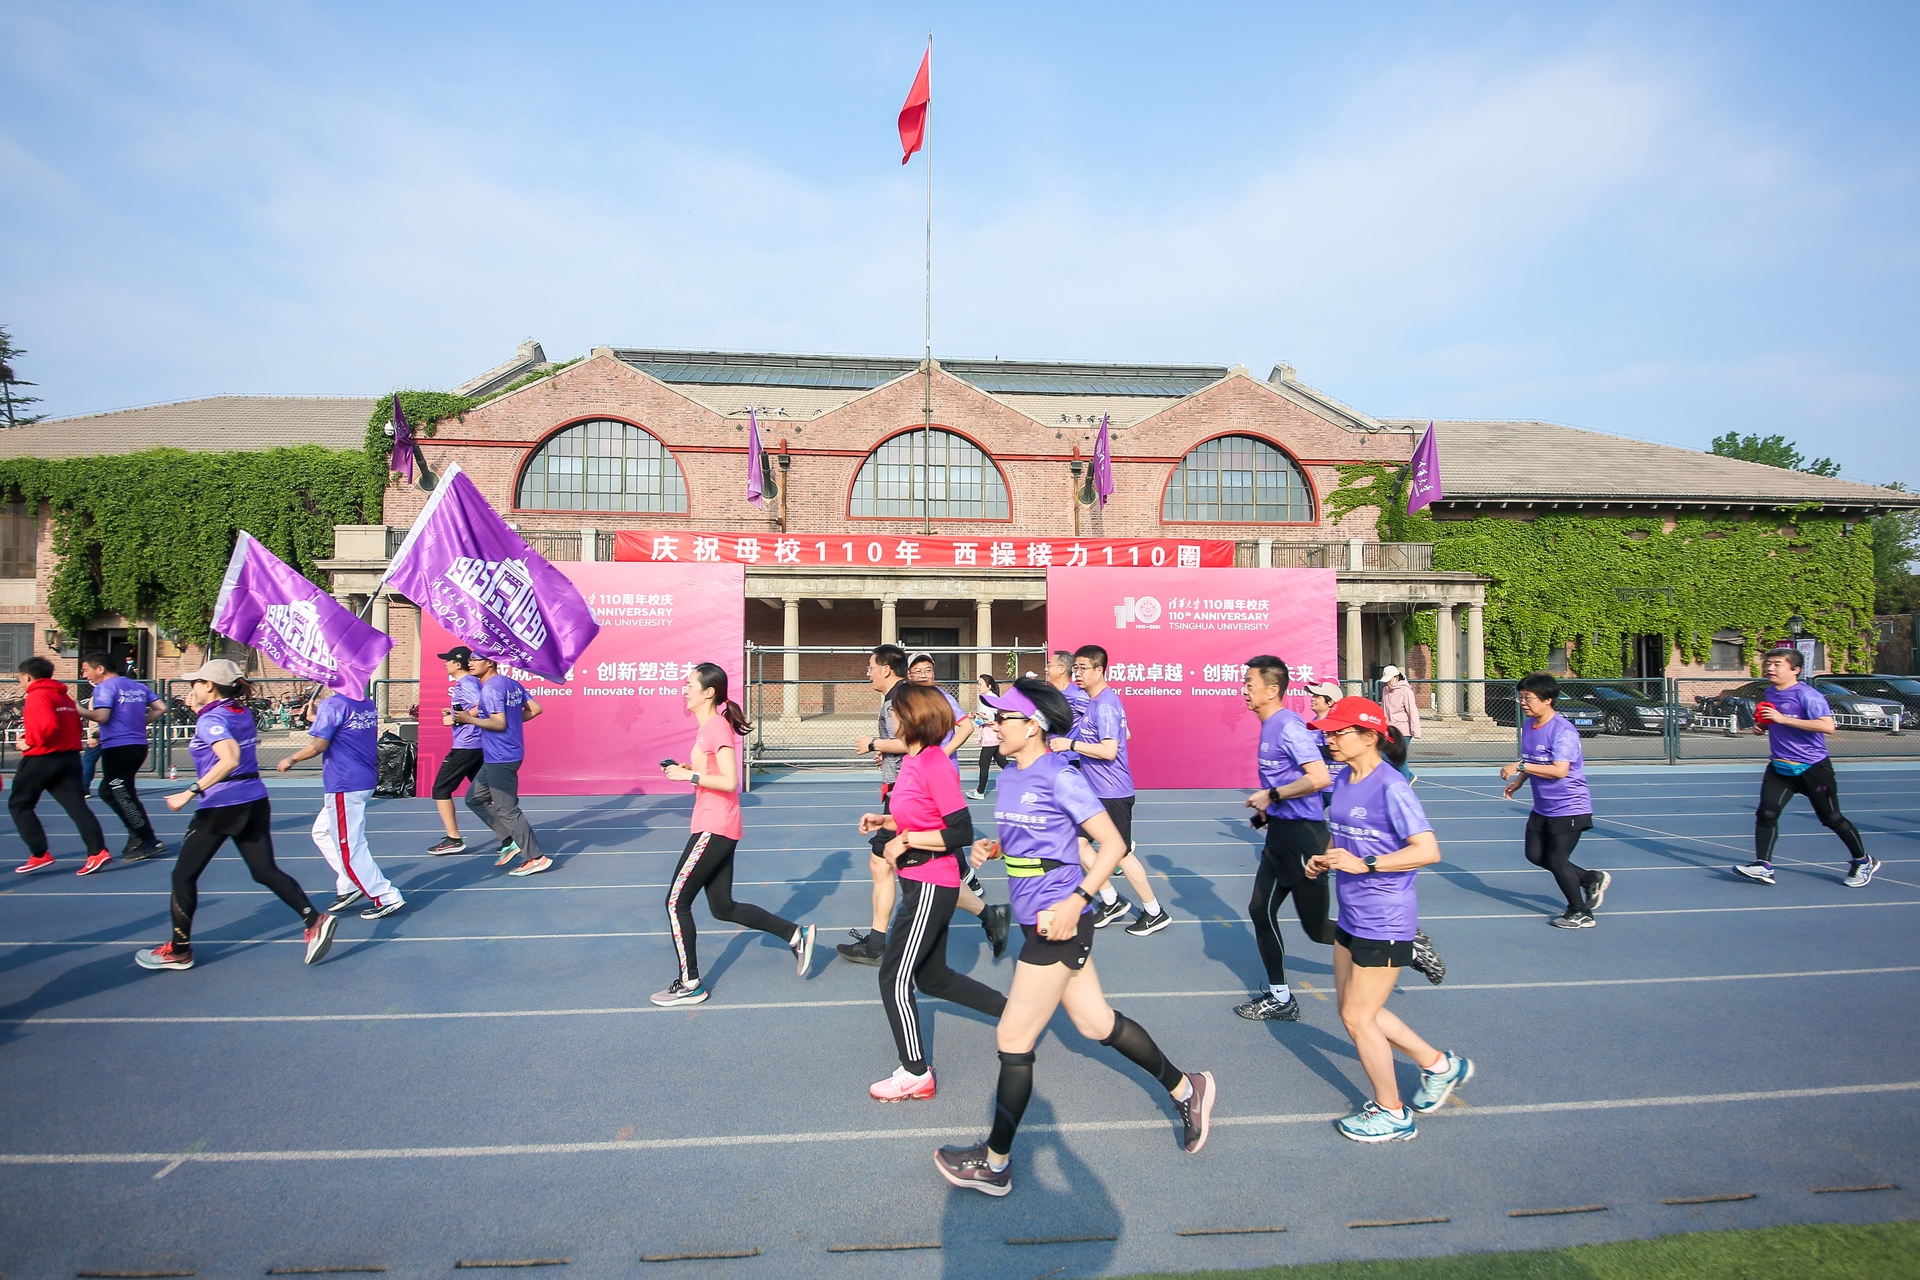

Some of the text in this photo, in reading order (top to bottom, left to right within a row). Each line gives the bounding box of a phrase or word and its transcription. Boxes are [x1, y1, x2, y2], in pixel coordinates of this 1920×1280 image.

[651, 536, 1201, 568] 庆祝母校110年 西操接力110圈
[431, 598, 467, 629] 2020
[1169, 611, 1269, 621] 110th ANNIVERSARY
[1169, 622, 1270, 631] TSINGHUA UNIVERSITY
[258, 637, 281, 660] 2020
[526, 687, 572, 697] cellence
[583, 686, 635, 696] Innovate
[638, 686, 655, 696] for
[659, 686, 678, 696] the
[1110, 686, 1122, 696] or
[1125, 686, 1182, 696] Excellence
[1191, 687, 1238, 696] Innovate
